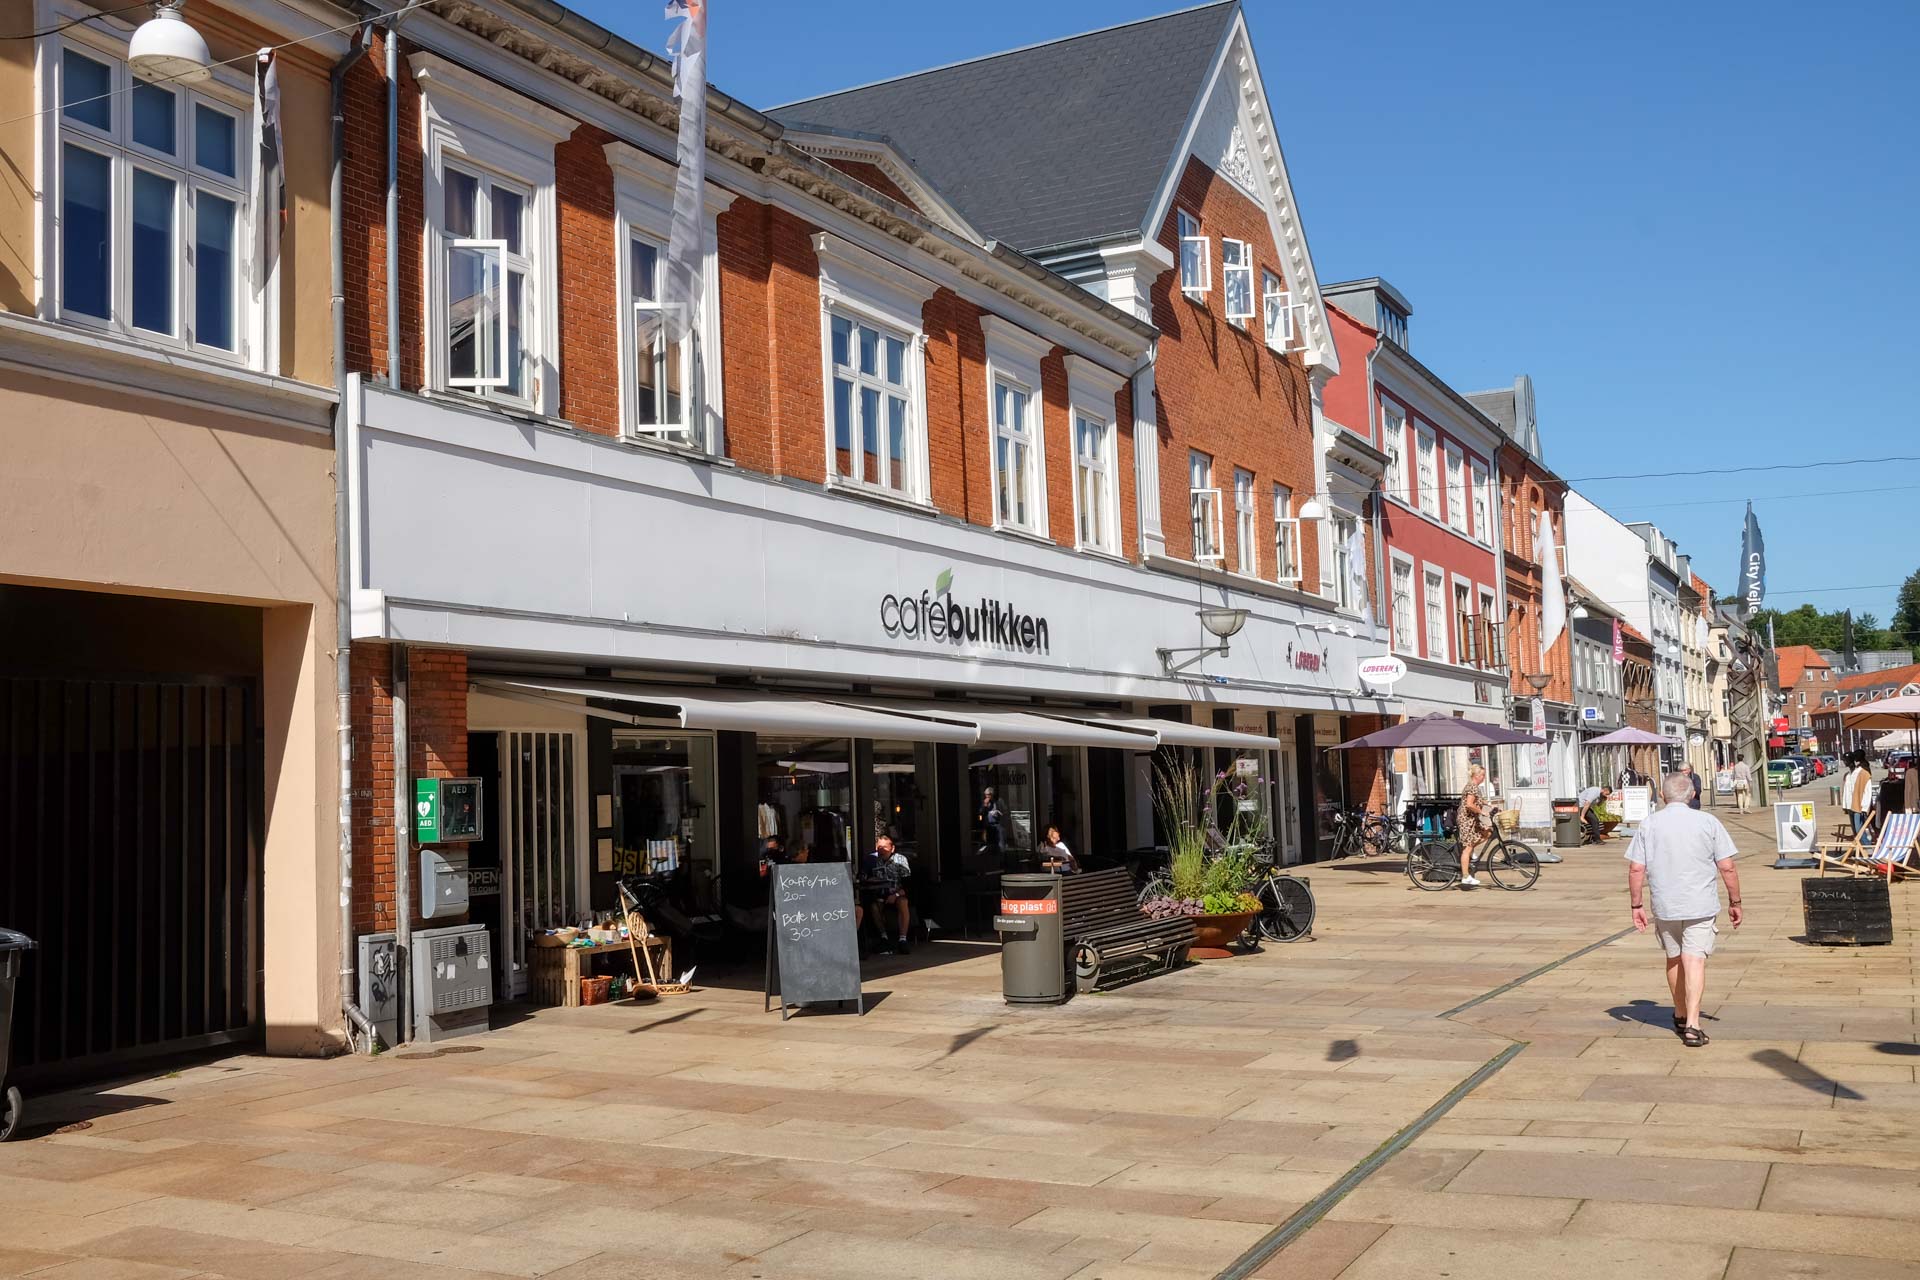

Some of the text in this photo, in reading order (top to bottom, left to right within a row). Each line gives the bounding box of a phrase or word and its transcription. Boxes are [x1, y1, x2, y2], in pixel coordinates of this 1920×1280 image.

[1746, 552, 1761, 615] City Vejle
[451, 785, 468, 794] AED
[1008, 903, 1018, 914] og
[1020, 901, 1043, 914] plast
